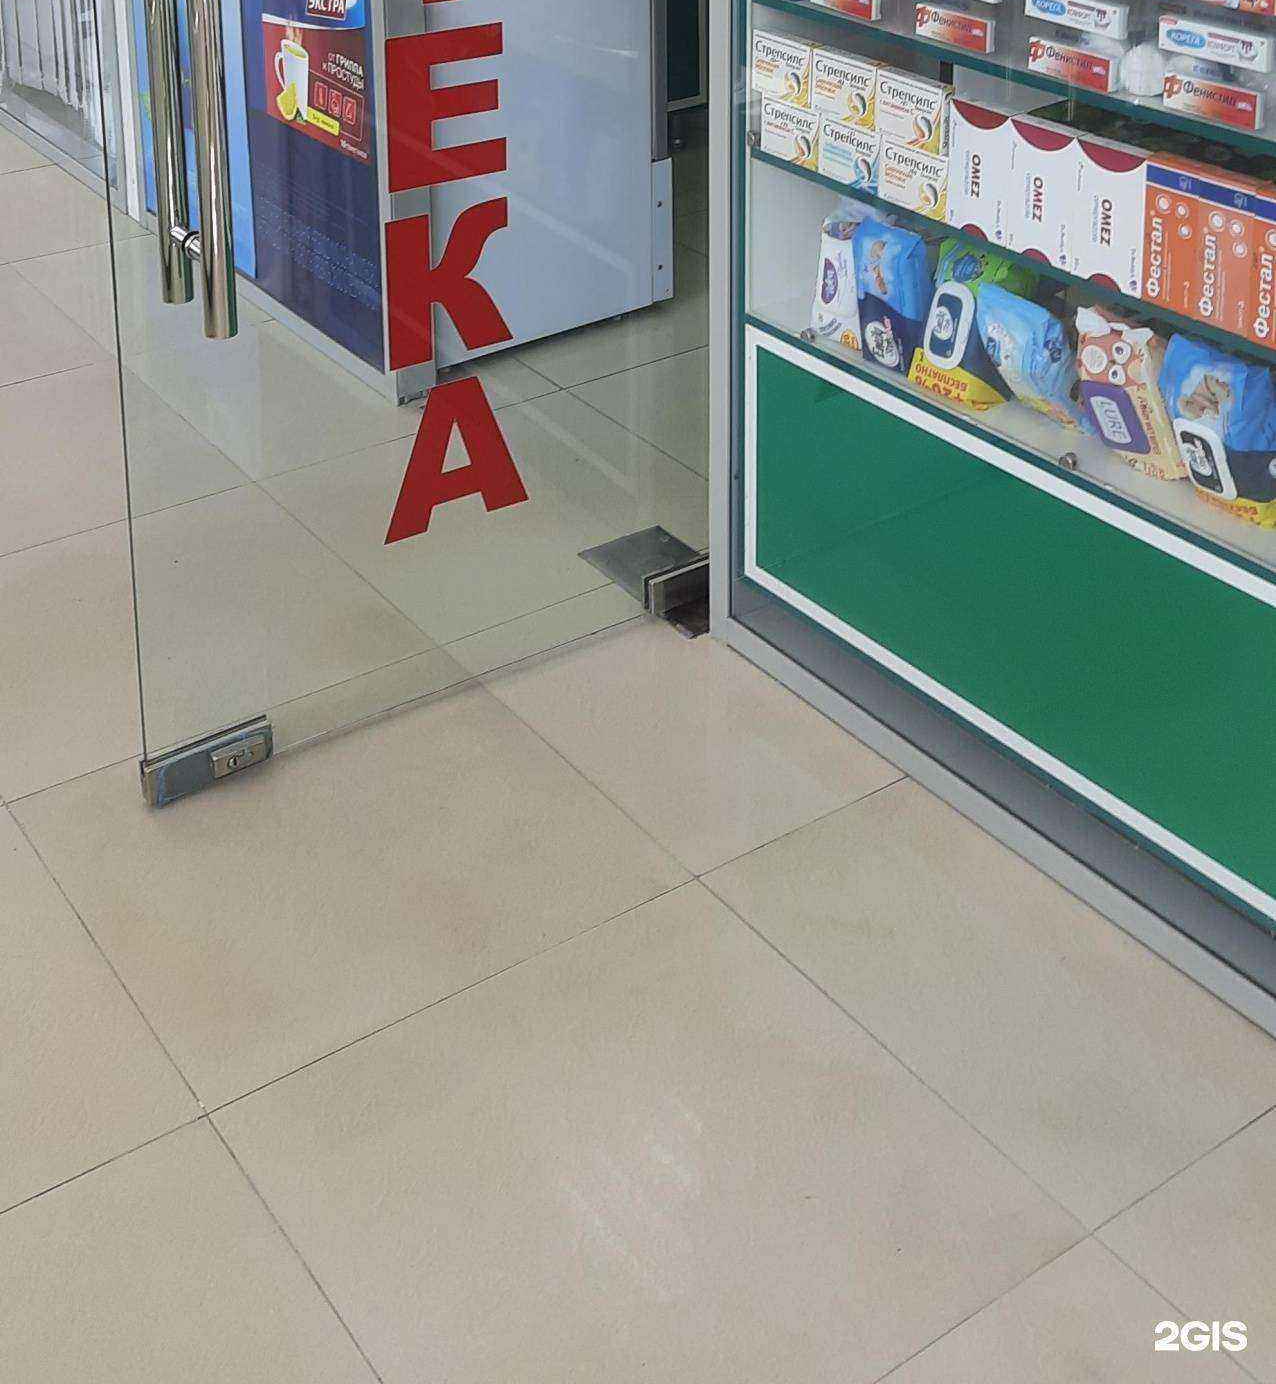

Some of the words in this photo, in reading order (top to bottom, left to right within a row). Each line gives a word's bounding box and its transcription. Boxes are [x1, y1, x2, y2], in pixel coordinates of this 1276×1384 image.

[755, 40, 804, 66] Стрепсилс
[815, 59, 872, 87] Стрепсилс
[880, 81, 937, 110] Стрепсилс
[764, 103, 815, 131] Стрепсилс
[823, 123, 877, 154] Стрепсилс
[885, 146, 943, 177] Стрепсилс
[971, 154, 981, 199] OMEZ
[1032, 176, 1044, 223] OMEZ
[1100, 199, 1113, 248] OMEZ
[1146, 217, 1163, 298] Фестал
[1199, 234, 1217, 317] Фестал
[1253, 253, 1274, 339] Фестал
